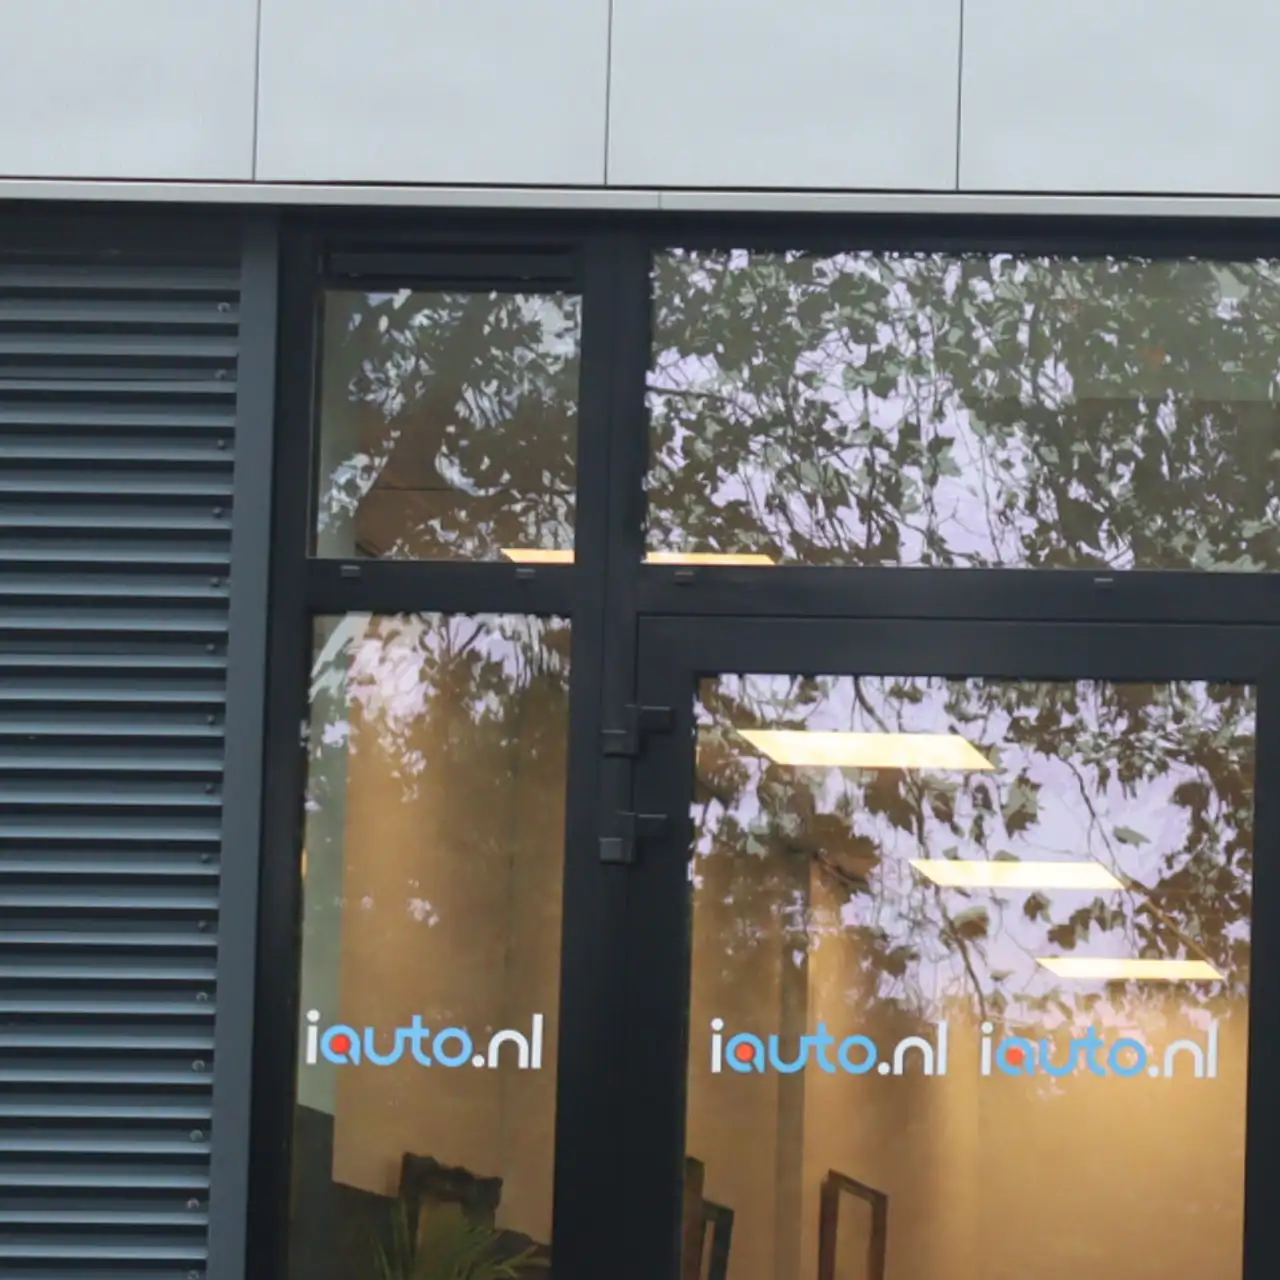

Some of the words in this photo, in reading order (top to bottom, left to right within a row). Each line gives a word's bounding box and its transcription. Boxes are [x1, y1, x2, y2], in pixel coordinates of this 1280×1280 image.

[307, 1009, 543, 1069] iauto.nl
[712, 1018, 948, 1075] iauto.nl
[982, 1021, 1218, 1078] iauto.nl
